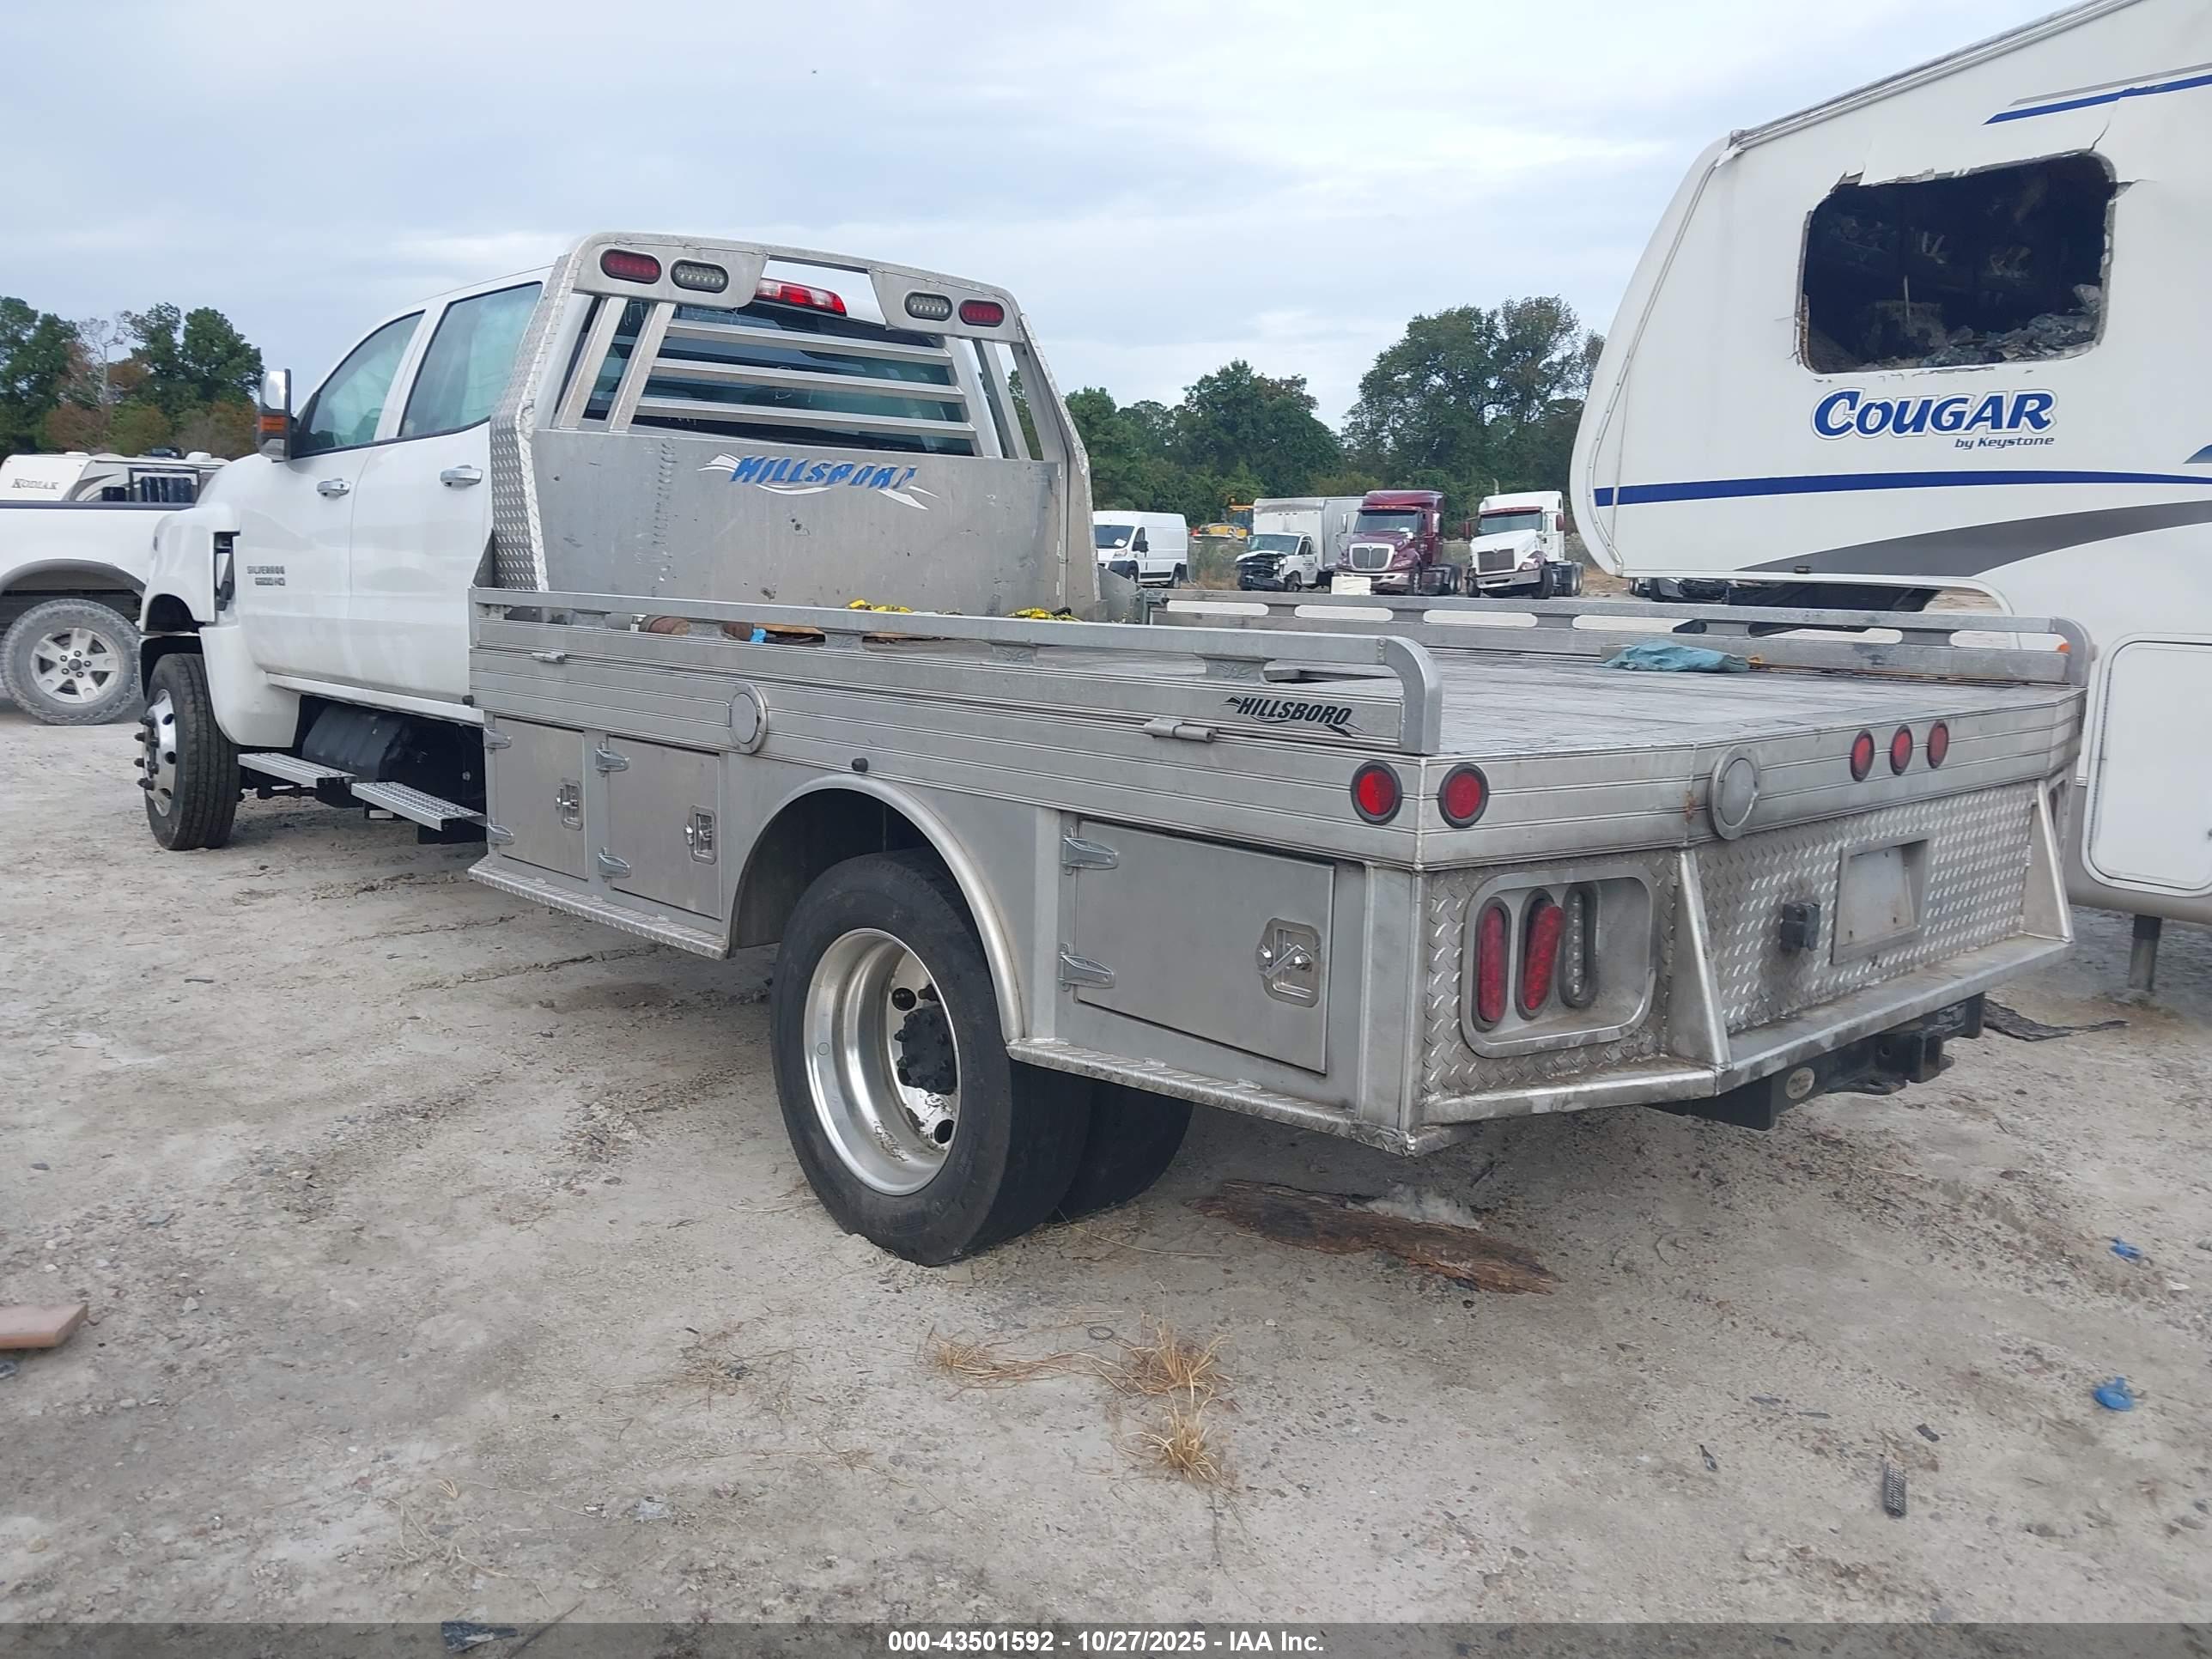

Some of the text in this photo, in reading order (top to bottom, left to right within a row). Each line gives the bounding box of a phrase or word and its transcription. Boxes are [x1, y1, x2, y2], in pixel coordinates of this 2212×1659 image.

[1813, 389, 2055, 438] COUGAR
[1954, 436, 2055, 450] by Keystone
[1237, 696, 1352, 726] HILLSBORO
